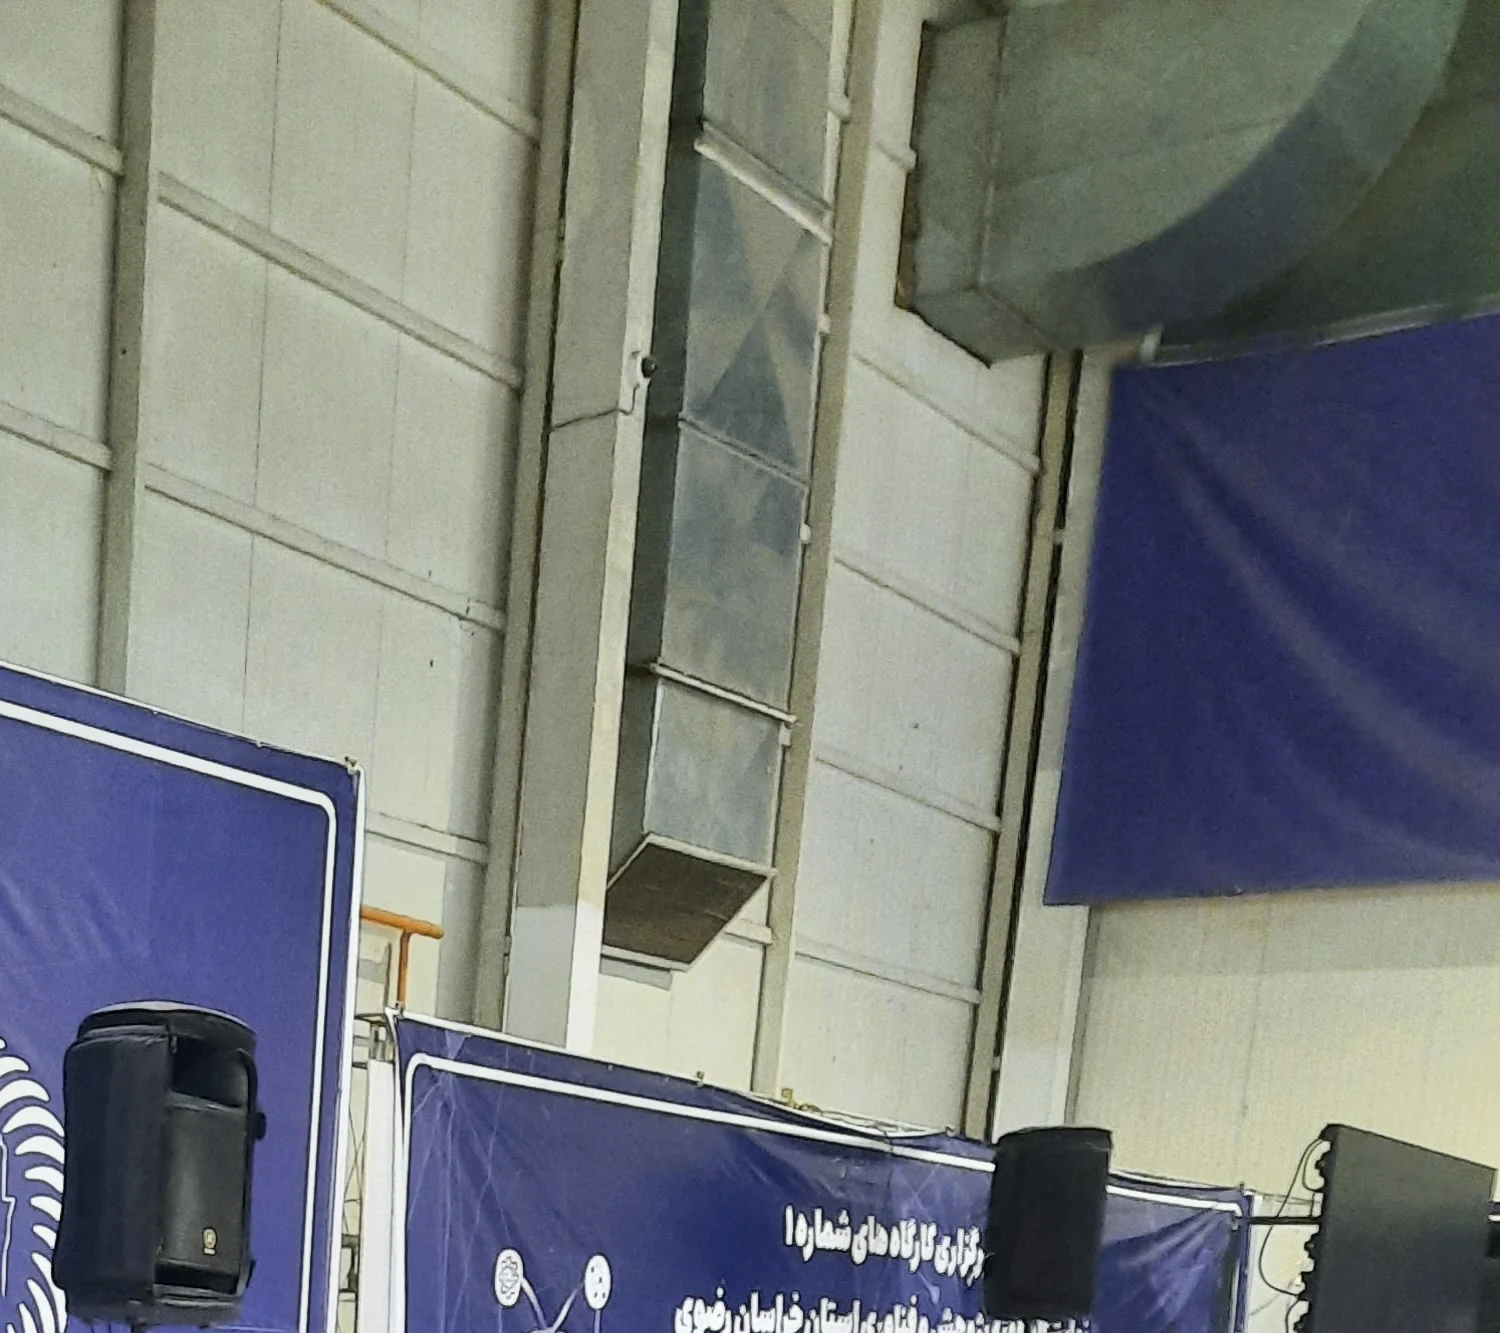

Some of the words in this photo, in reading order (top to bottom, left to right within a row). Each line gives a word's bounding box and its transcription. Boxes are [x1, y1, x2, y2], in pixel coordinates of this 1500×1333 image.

[795, 1207, 851, 1262] شماره
[851, 1215, 889, 1265] های
[889, 1217, 938, 1274] کارگاه
[933, 1225, 985, 1288] رگزاری
